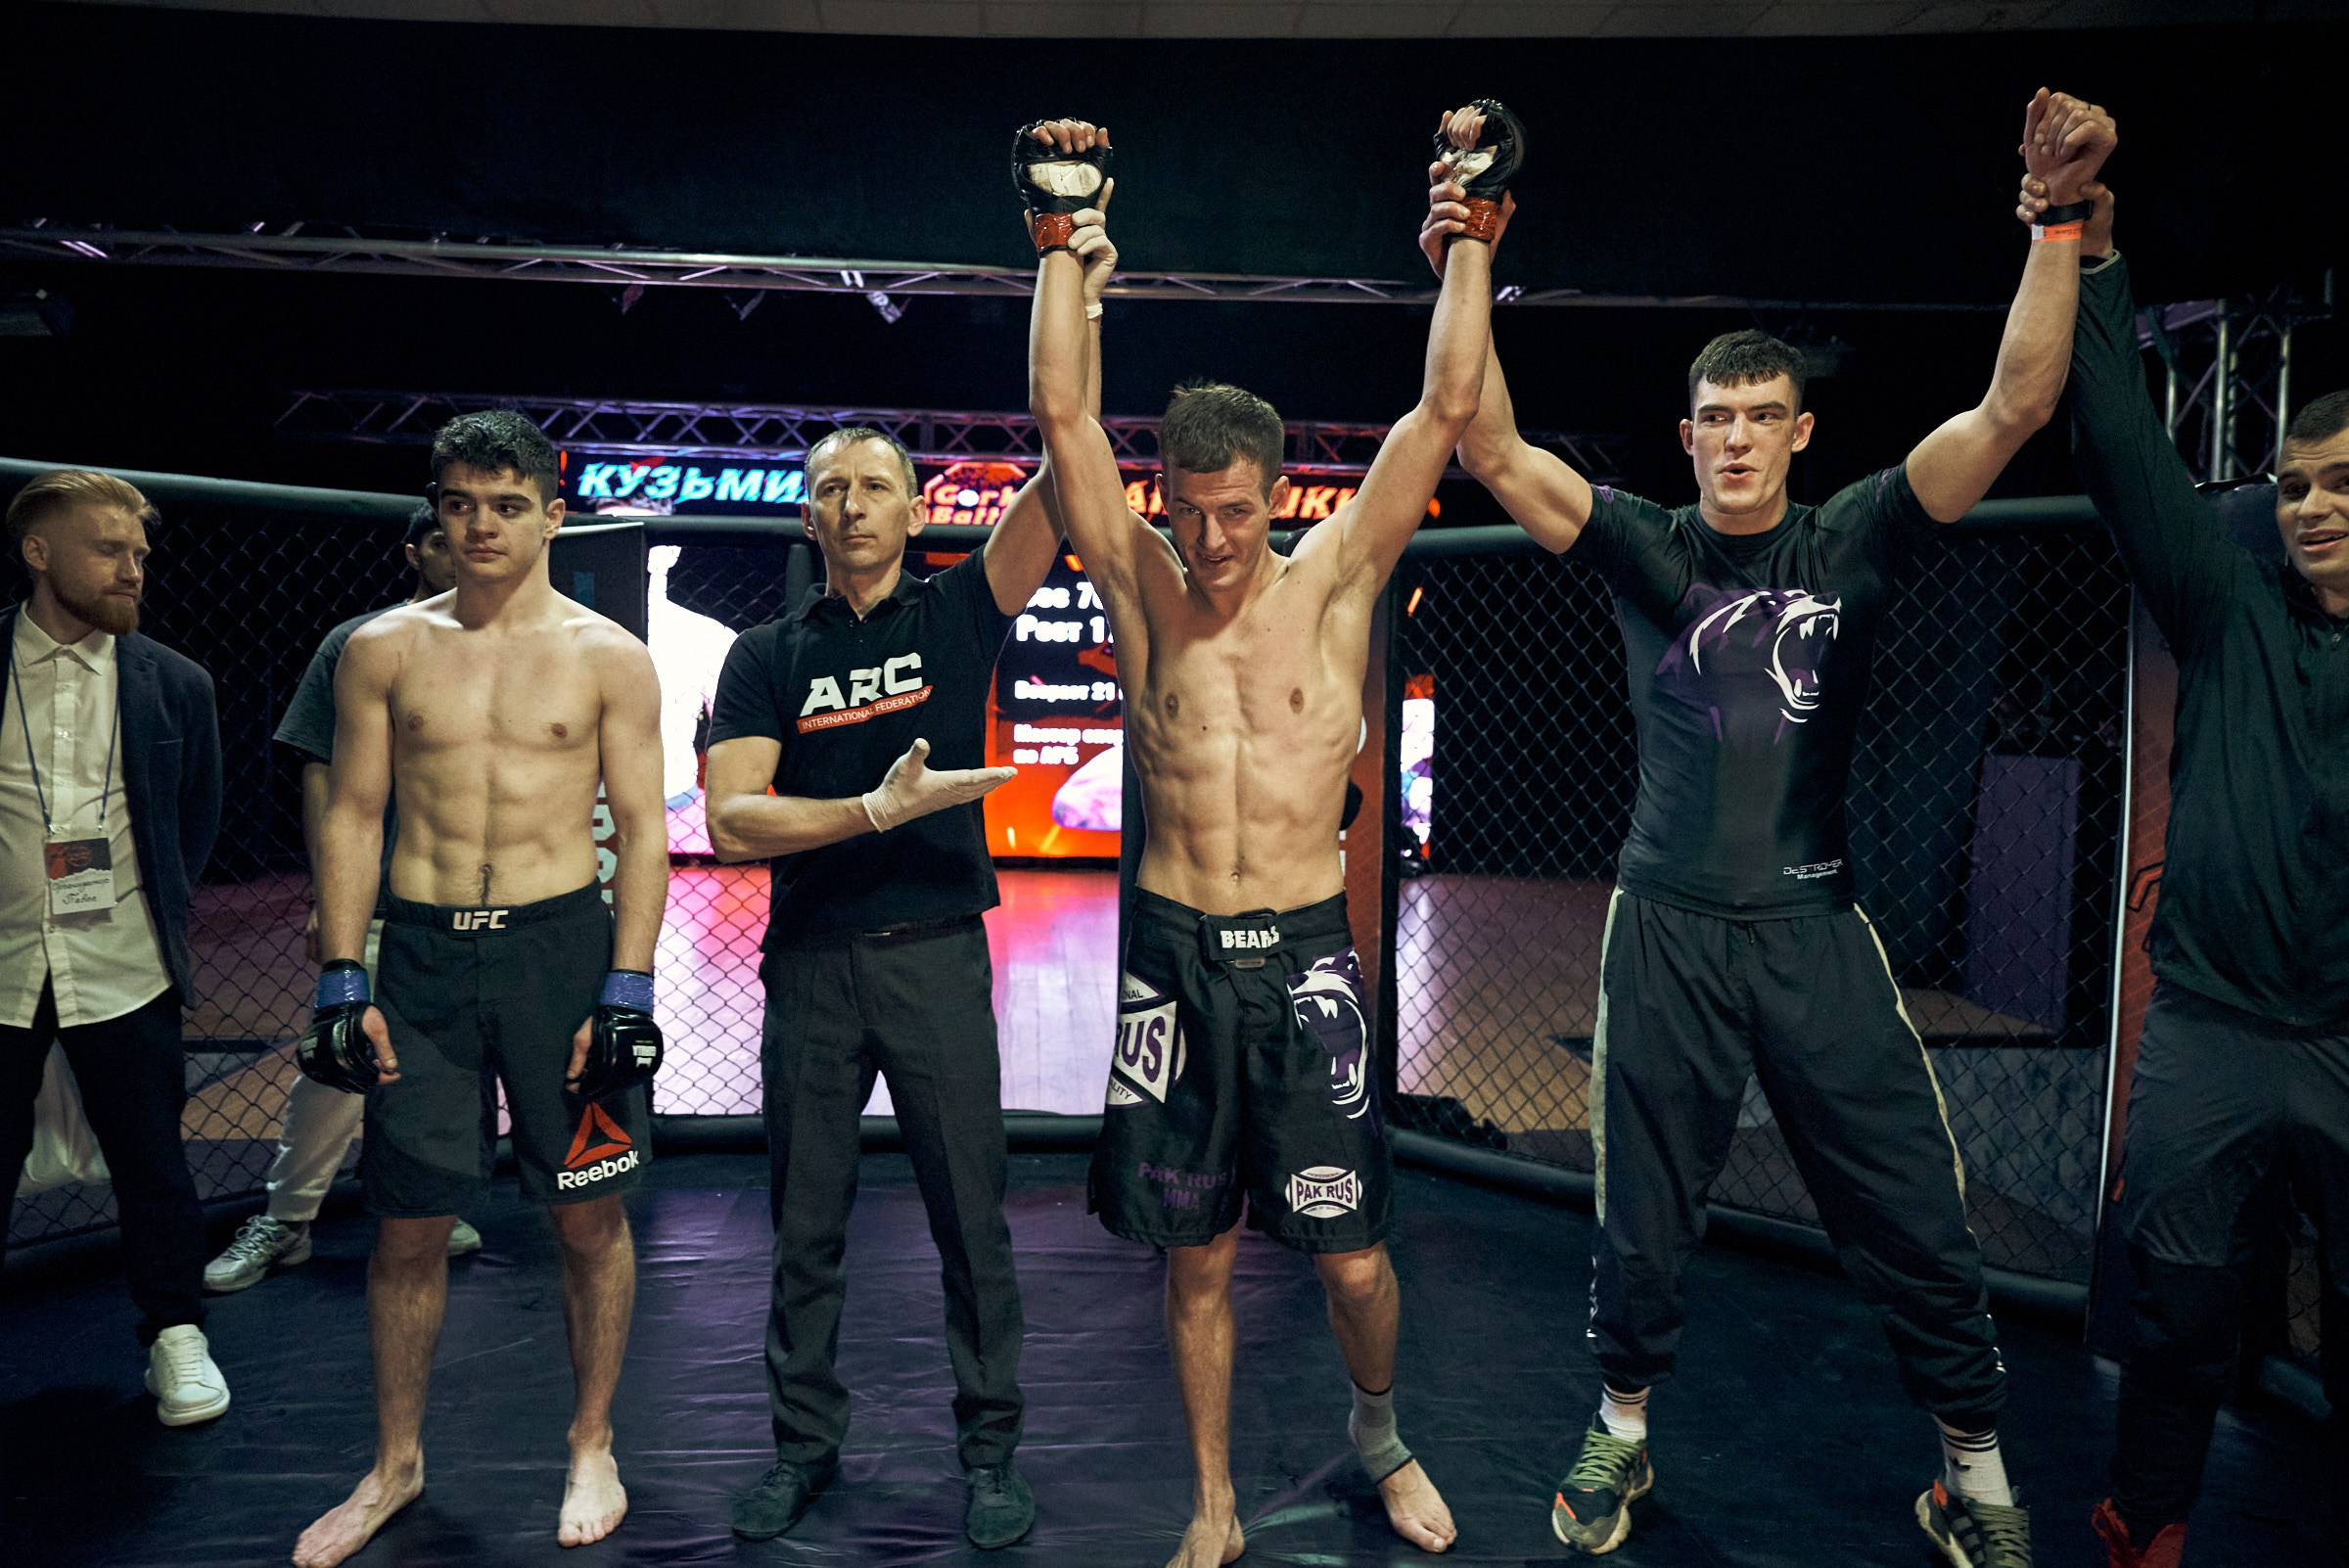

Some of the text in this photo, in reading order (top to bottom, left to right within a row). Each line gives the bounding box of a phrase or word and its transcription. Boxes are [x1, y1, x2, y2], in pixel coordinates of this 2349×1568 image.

[577, 462, 808, 504] КУЗЬМИ
[930, 505, 1007, 526] Batt
[799, 652, 923, 717] ARC
[803, 689, 932, 730] INTERNATIONAL FEDERATION
[453, 910, 509, 930] UFC
[557, 1150, 639, 1190] Reebok
[1296, 1177, 1354, 1206] PAK RUS
